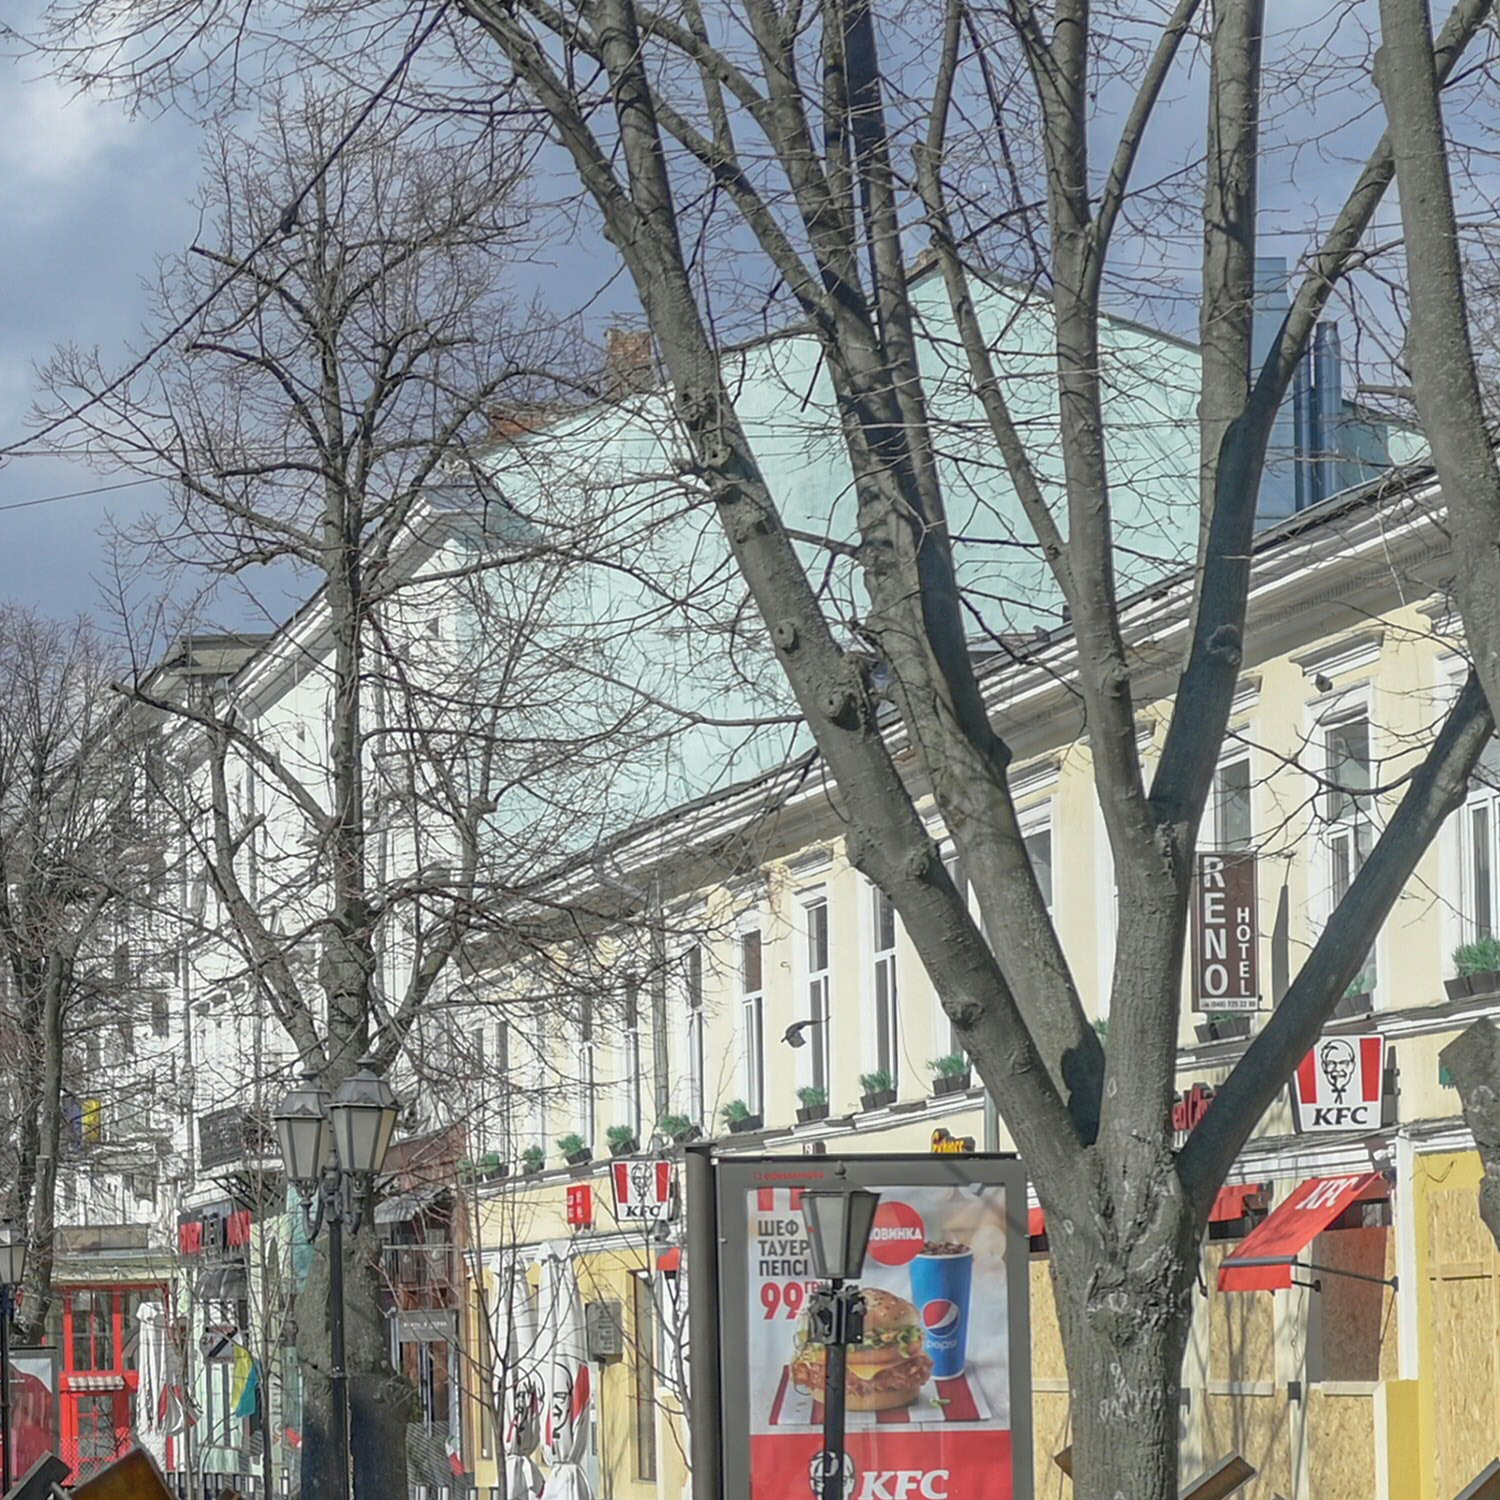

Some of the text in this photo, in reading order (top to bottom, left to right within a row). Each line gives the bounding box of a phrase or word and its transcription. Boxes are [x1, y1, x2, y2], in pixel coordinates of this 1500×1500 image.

[1203, 856, 1229, 996] RENO
[1236, 906, 1251, 996] HOTEL
[1312, 1106, 1368, 1126] KFC
[626, 1205, 661, 1217] KFC
[758, 1219, 799, 1237] ШЕФ
[758, 1240, 810, 1256] ТАУЕР
[759, 1259, 808, 1277] ПЕПСІ
[760, 1281, 804, 1320] 99
